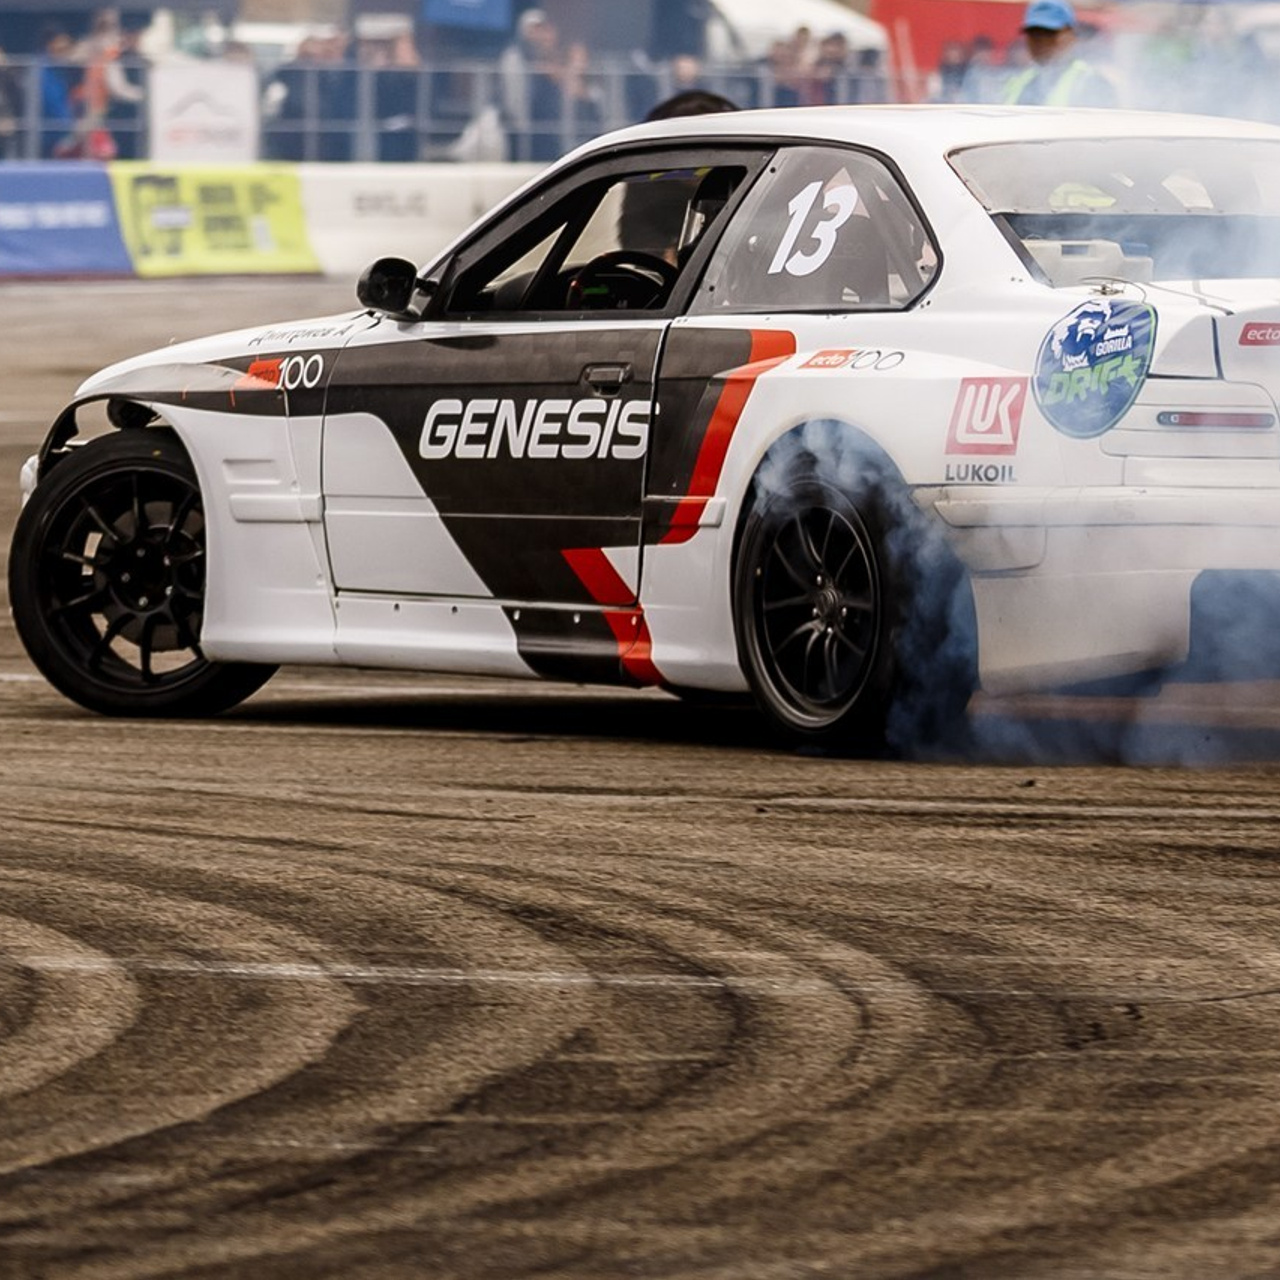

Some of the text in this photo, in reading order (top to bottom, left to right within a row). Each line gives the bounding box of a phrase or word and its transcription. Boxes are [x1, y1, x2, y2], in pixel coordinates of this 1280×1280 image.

[767, 181, 859, 276] 13
[1096, 335, 1132, 356] GORILLA
[418, 399, 660, 459] GENESIS
[945, 463, 1018, 482] LUKOIL
